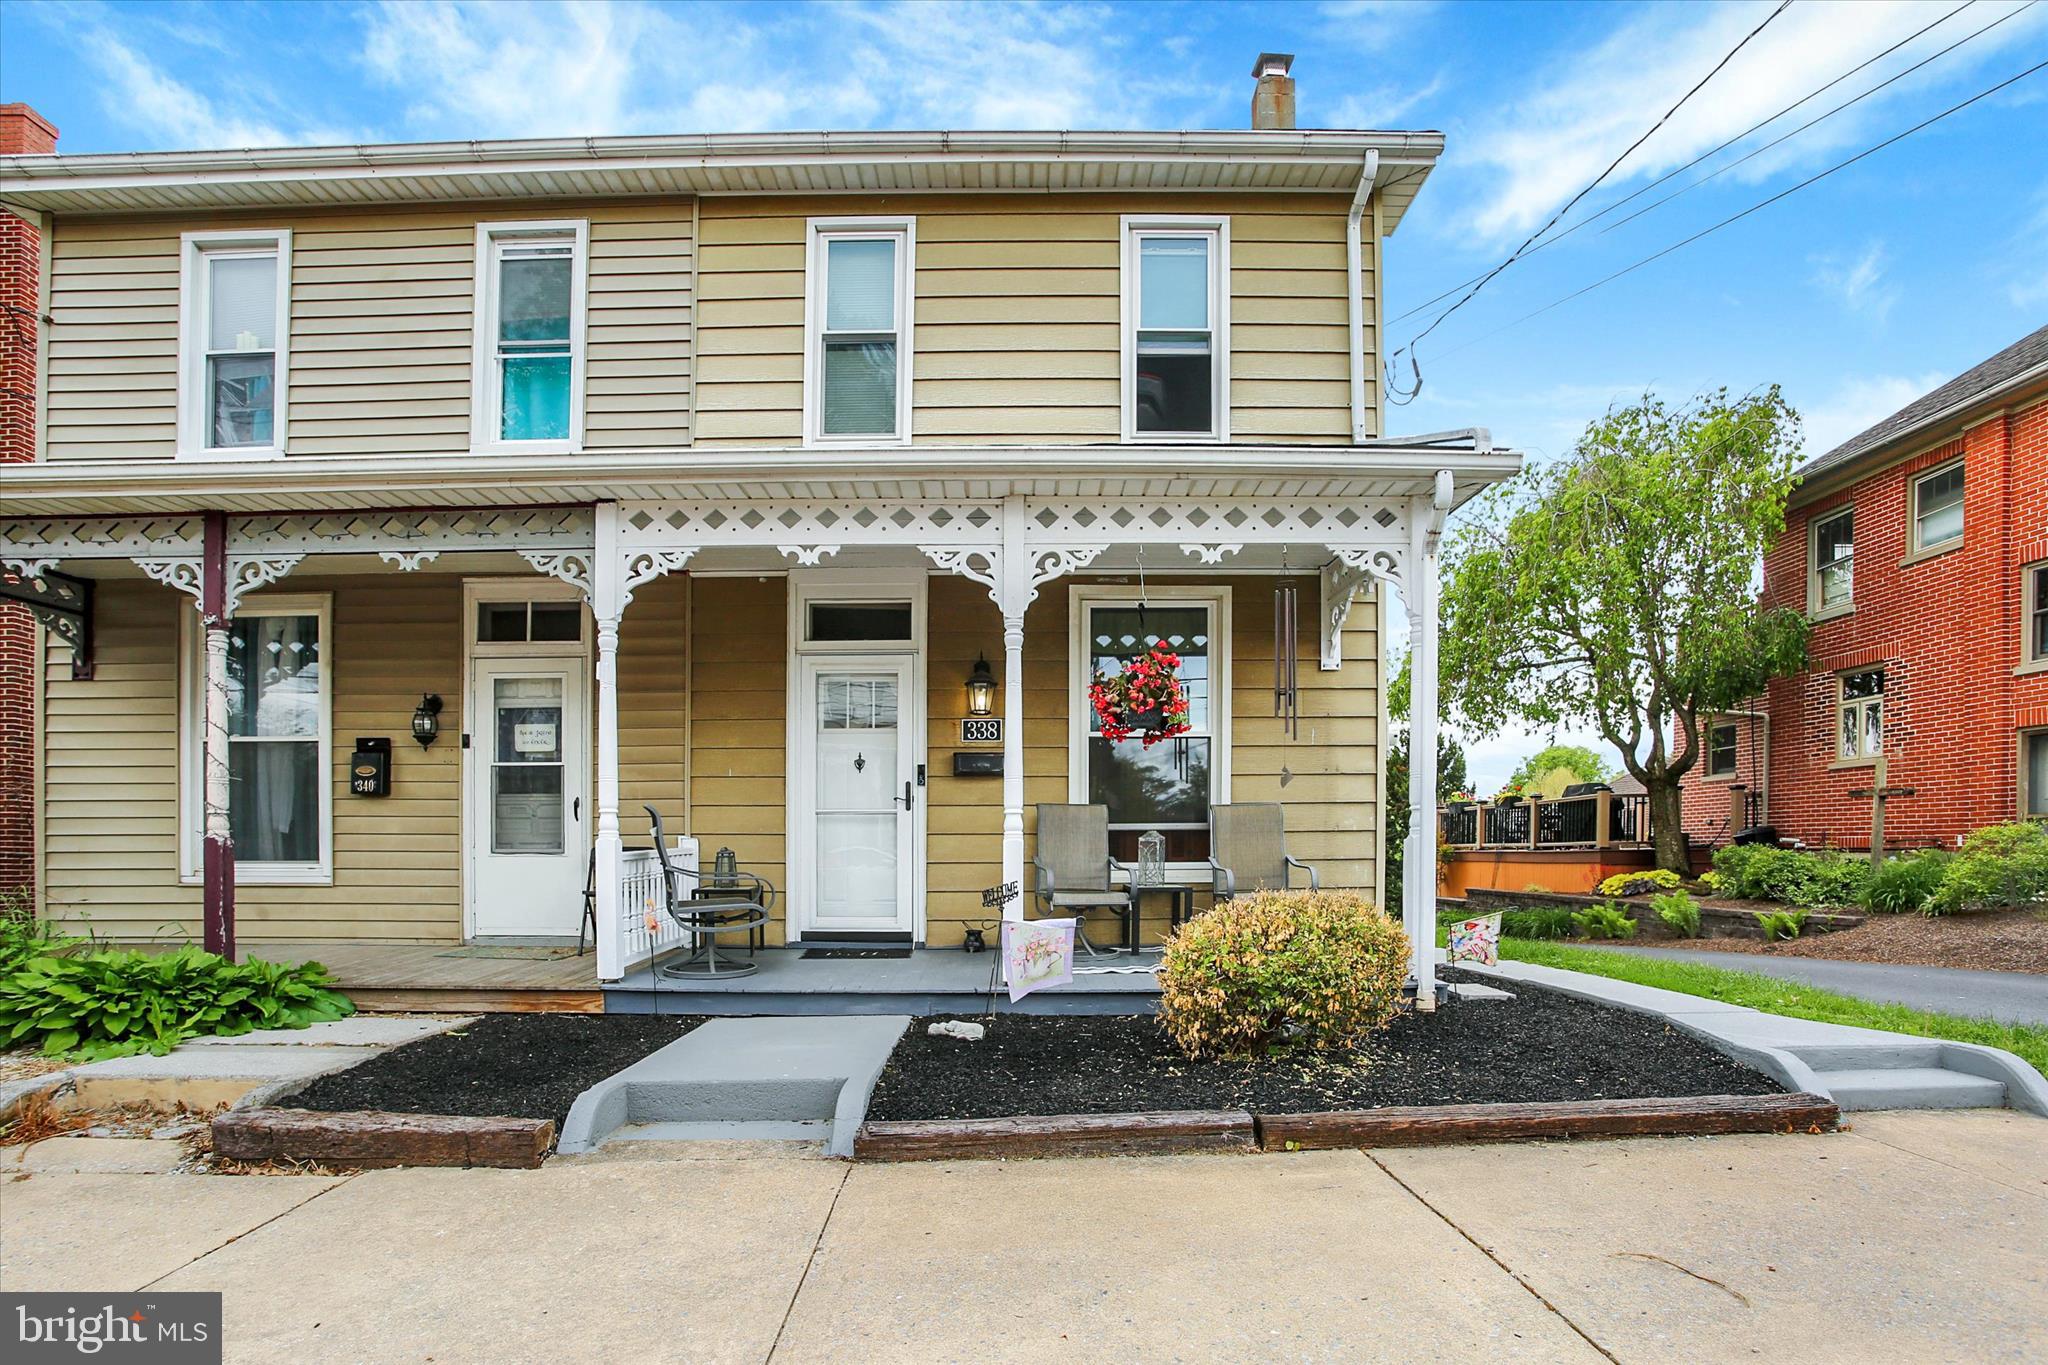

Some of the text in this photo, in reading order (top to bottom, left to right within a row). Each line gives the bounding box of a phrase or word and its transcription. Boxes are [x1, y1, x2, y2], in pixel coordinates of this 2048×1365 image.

[967, 721, 998, 740] 338
[357, 779, 374, 792] 340
[982, 880, 1018, 904] WELCOME
